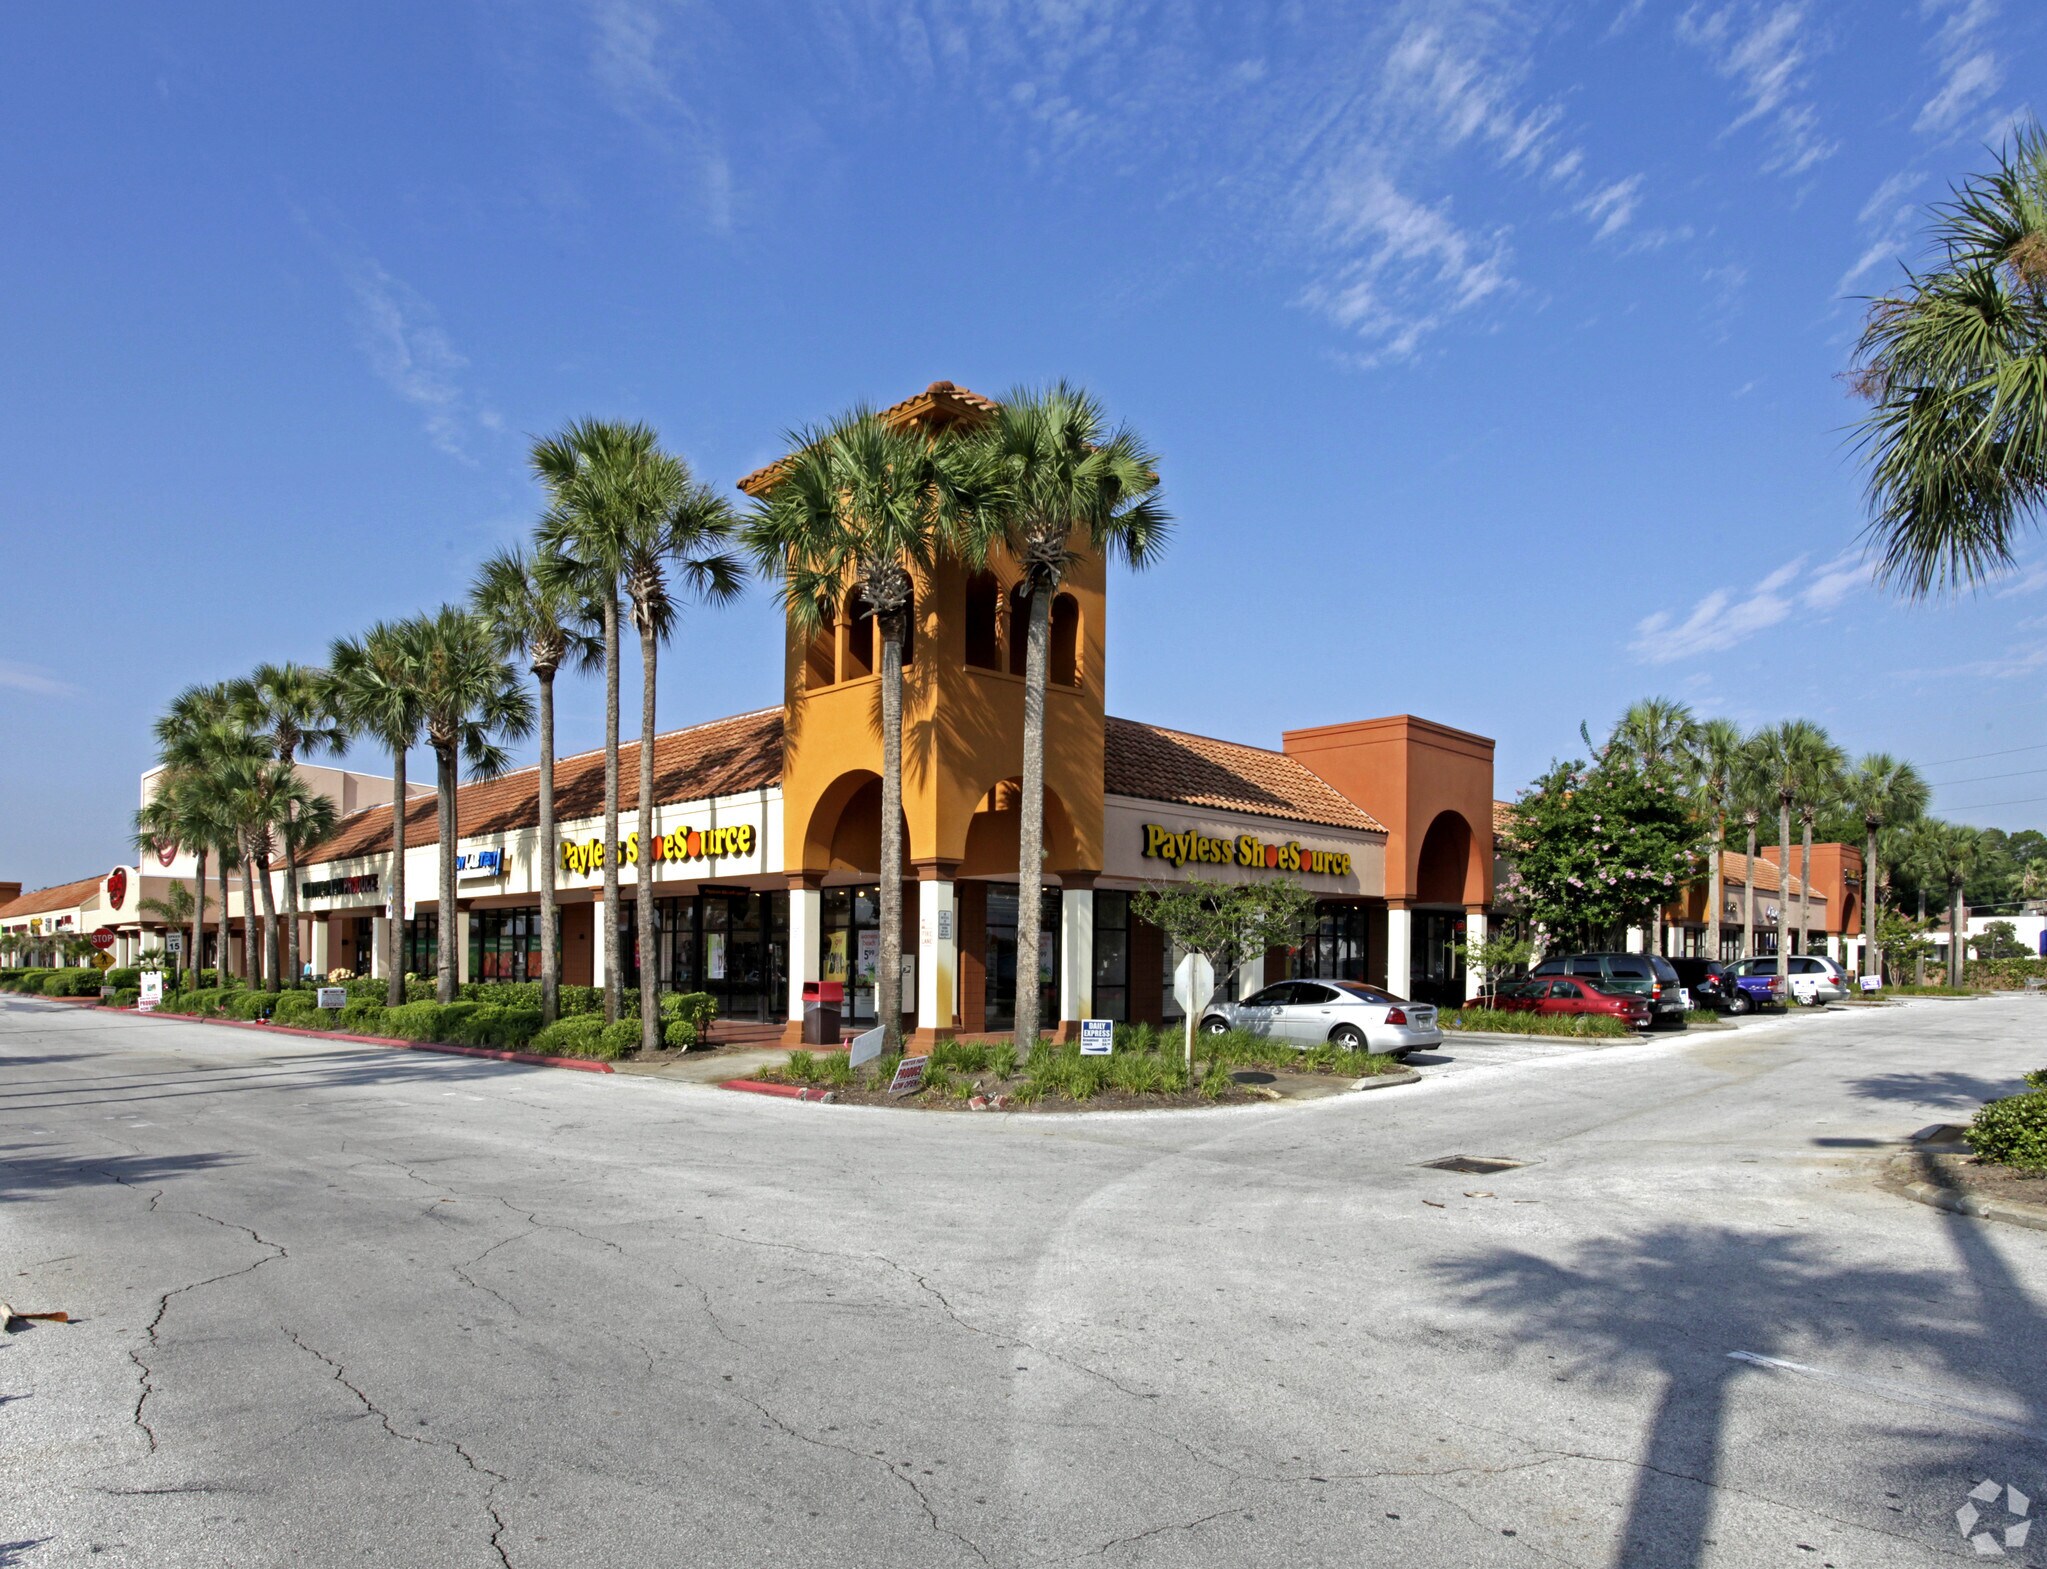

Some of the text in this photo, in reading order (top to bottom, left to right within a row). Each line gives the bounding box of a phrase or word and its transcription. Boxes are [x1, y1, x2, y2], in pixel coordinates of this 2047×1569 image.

[1147, 824, 1350, 875] Payless ShoeSource
[344, 873, 379, 895] PRODUCE
[92, 933, 113, 943] STOP
[169, 942, 180, 950] 15
[1089, 1022, 1106, 1030] DAILY
[1084, 1029, 1111, 1037] EXPRESS
[896, 1064, 923, 1079] PRODUCE
[891, 1082, 905, 1091] NOW
